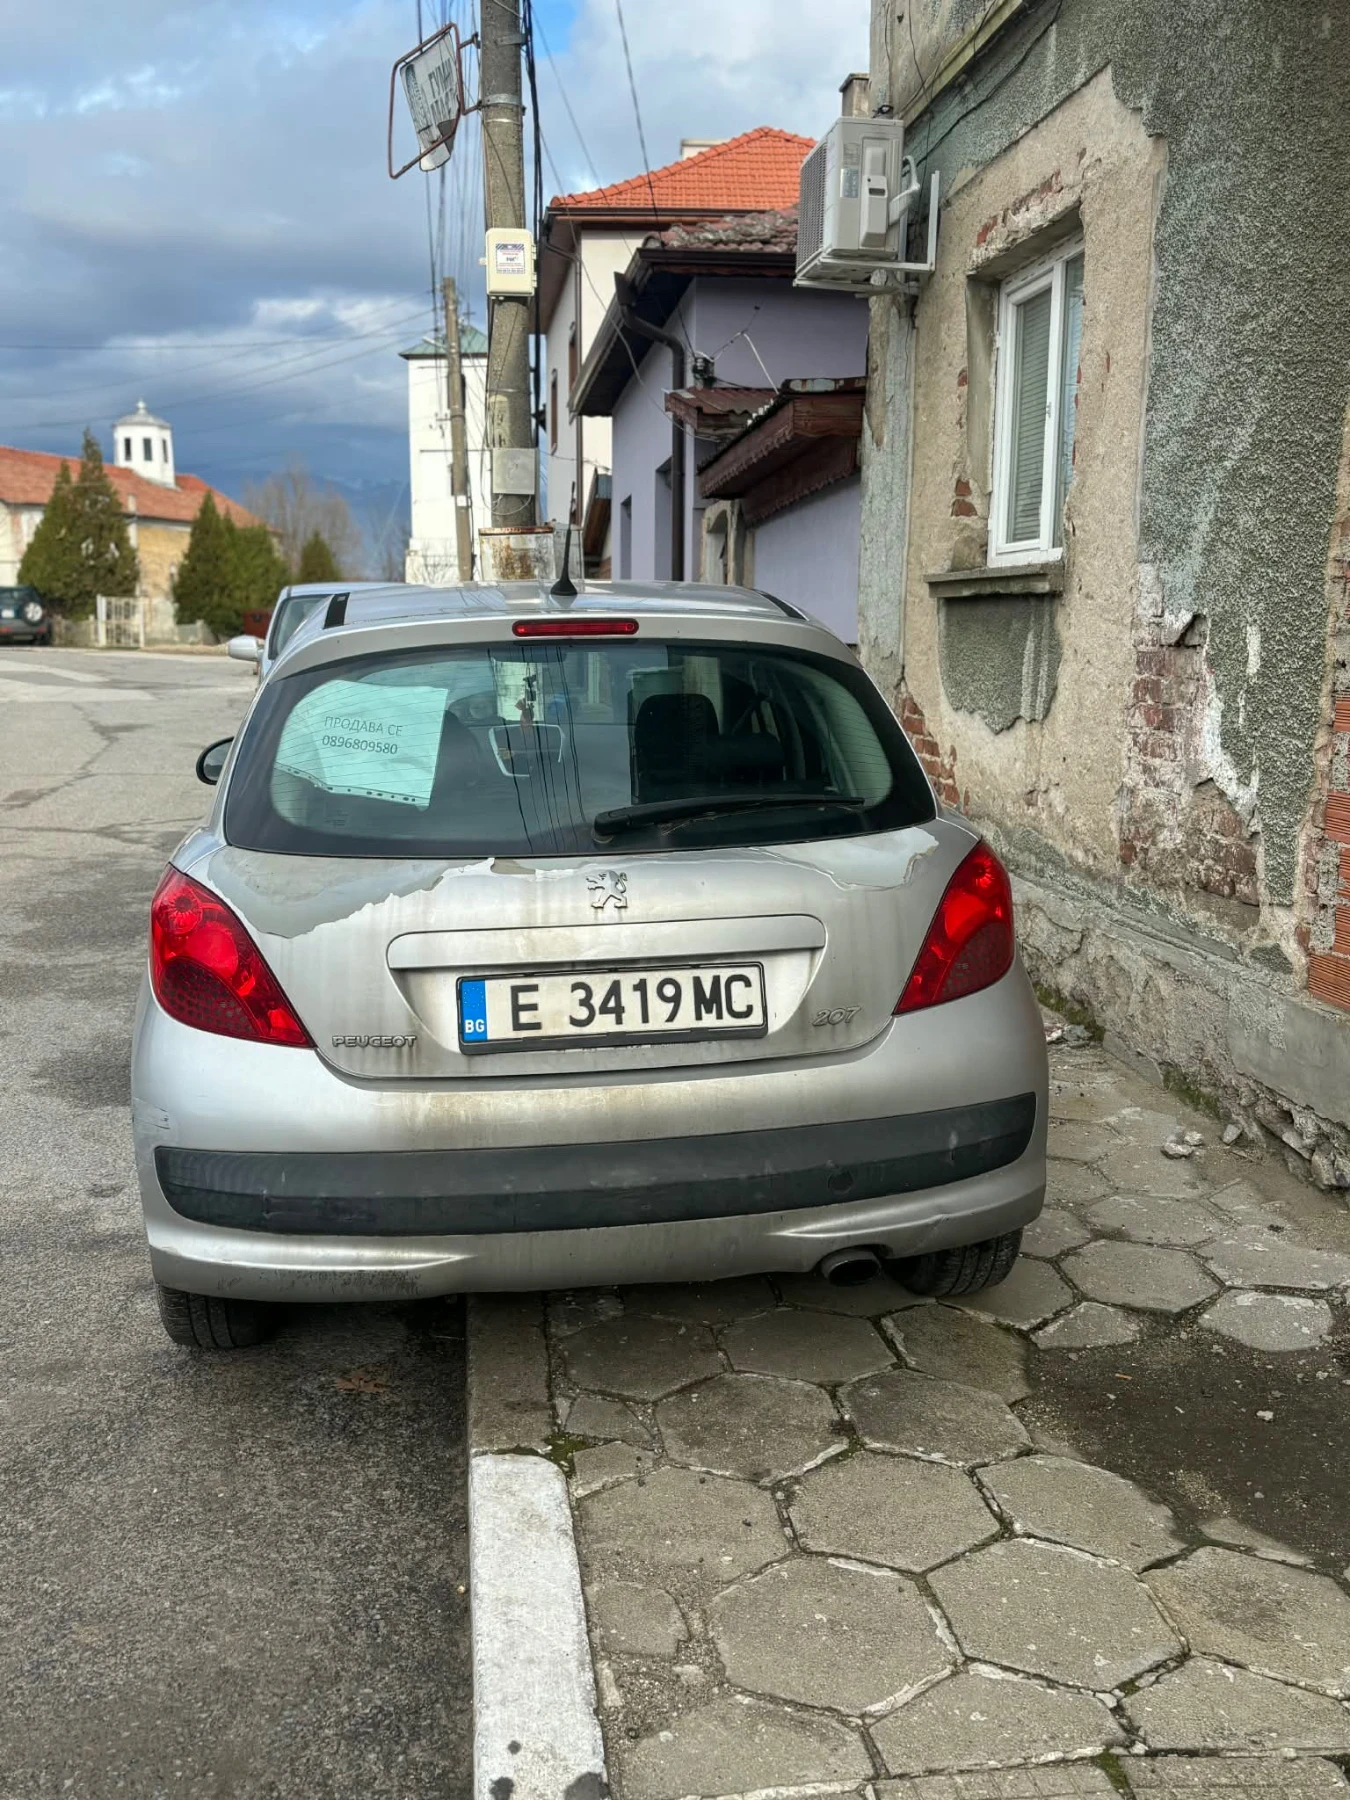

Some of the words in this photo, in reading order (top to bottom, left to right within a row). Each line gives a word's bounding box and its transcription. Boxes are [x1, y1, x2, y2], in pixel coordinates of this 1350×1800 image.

[324, 716, 384, 734] ПРОДАВА
[387, 724, 404, 737] СЕ
[322, 735, 398, 755] 0896809580
[510, 983, 542, 1032] E
[569, 977, 683, 1028] 3419
[692, 974, 753, 1021] MC
[812, 1005, 862, 1027] 207
[464, 1019, 485, 1034] BG
[332, 1034, 418, 1048] PEUGEOT
